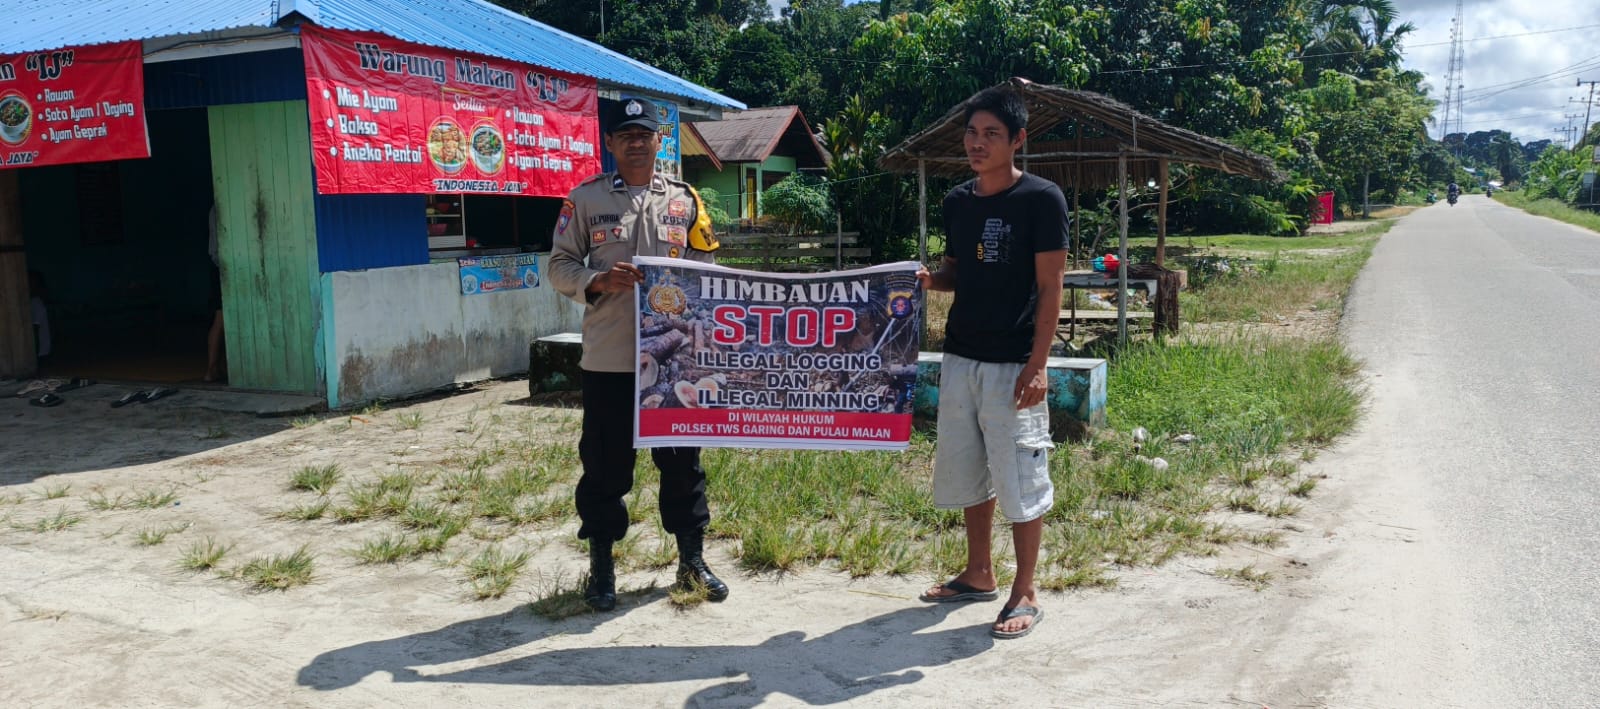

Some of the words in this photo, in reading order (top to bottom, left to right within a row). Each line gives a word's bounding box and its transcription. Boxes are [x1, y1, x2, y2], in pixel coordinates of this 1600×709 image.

[355, 42, 446, 83] Warung
[454, 57, 516, 90] Makan
[44, 88, 75, 103] Rawon
[336, 86, 360, 108] Mie
[362, 89, 398, 113] Ayam
[70, 104, 95, 122] Ayam
[103, 100, 135, 117] Daging
[513, 106, 544, 126] Rawon
[49, 126, 73, 144] Ayam
[338, 114, 378, 135] Bakso
[343, 141, 382, 161] Aneka
[383, 143, 423, 163] Pentol
[538, 131, 561, 151] Ayam
[567, 135, 594, 157] Daging
[514, 151, 541, 170] Ayam
[700, 275, 870, 303] HIMBAUAN
[712, 304, 857, 348] STOP
[697, 351, 781, 370] ILLEGAL
[786, 352, 881, 371] LOGGING
[766, 372, 809, 391] DAN
[698, 389, 781, 408] ILLEGAL
[785, 390, 879, 410] MINNING
[728, 411, 741, 422] DI
[742, 412, 790, 425] WILAYAH
[793, 414, 834, 425] HUKUM
[671, 422, 714, 435] POLSEK
[716, 423, 740, 435] TWS
[742, 424, 785, 436] GARING
[787, 425, 811, 437] DAN
[813, 426, 850, 438] PULAU
[853, 427, 891, 439] MALAN
